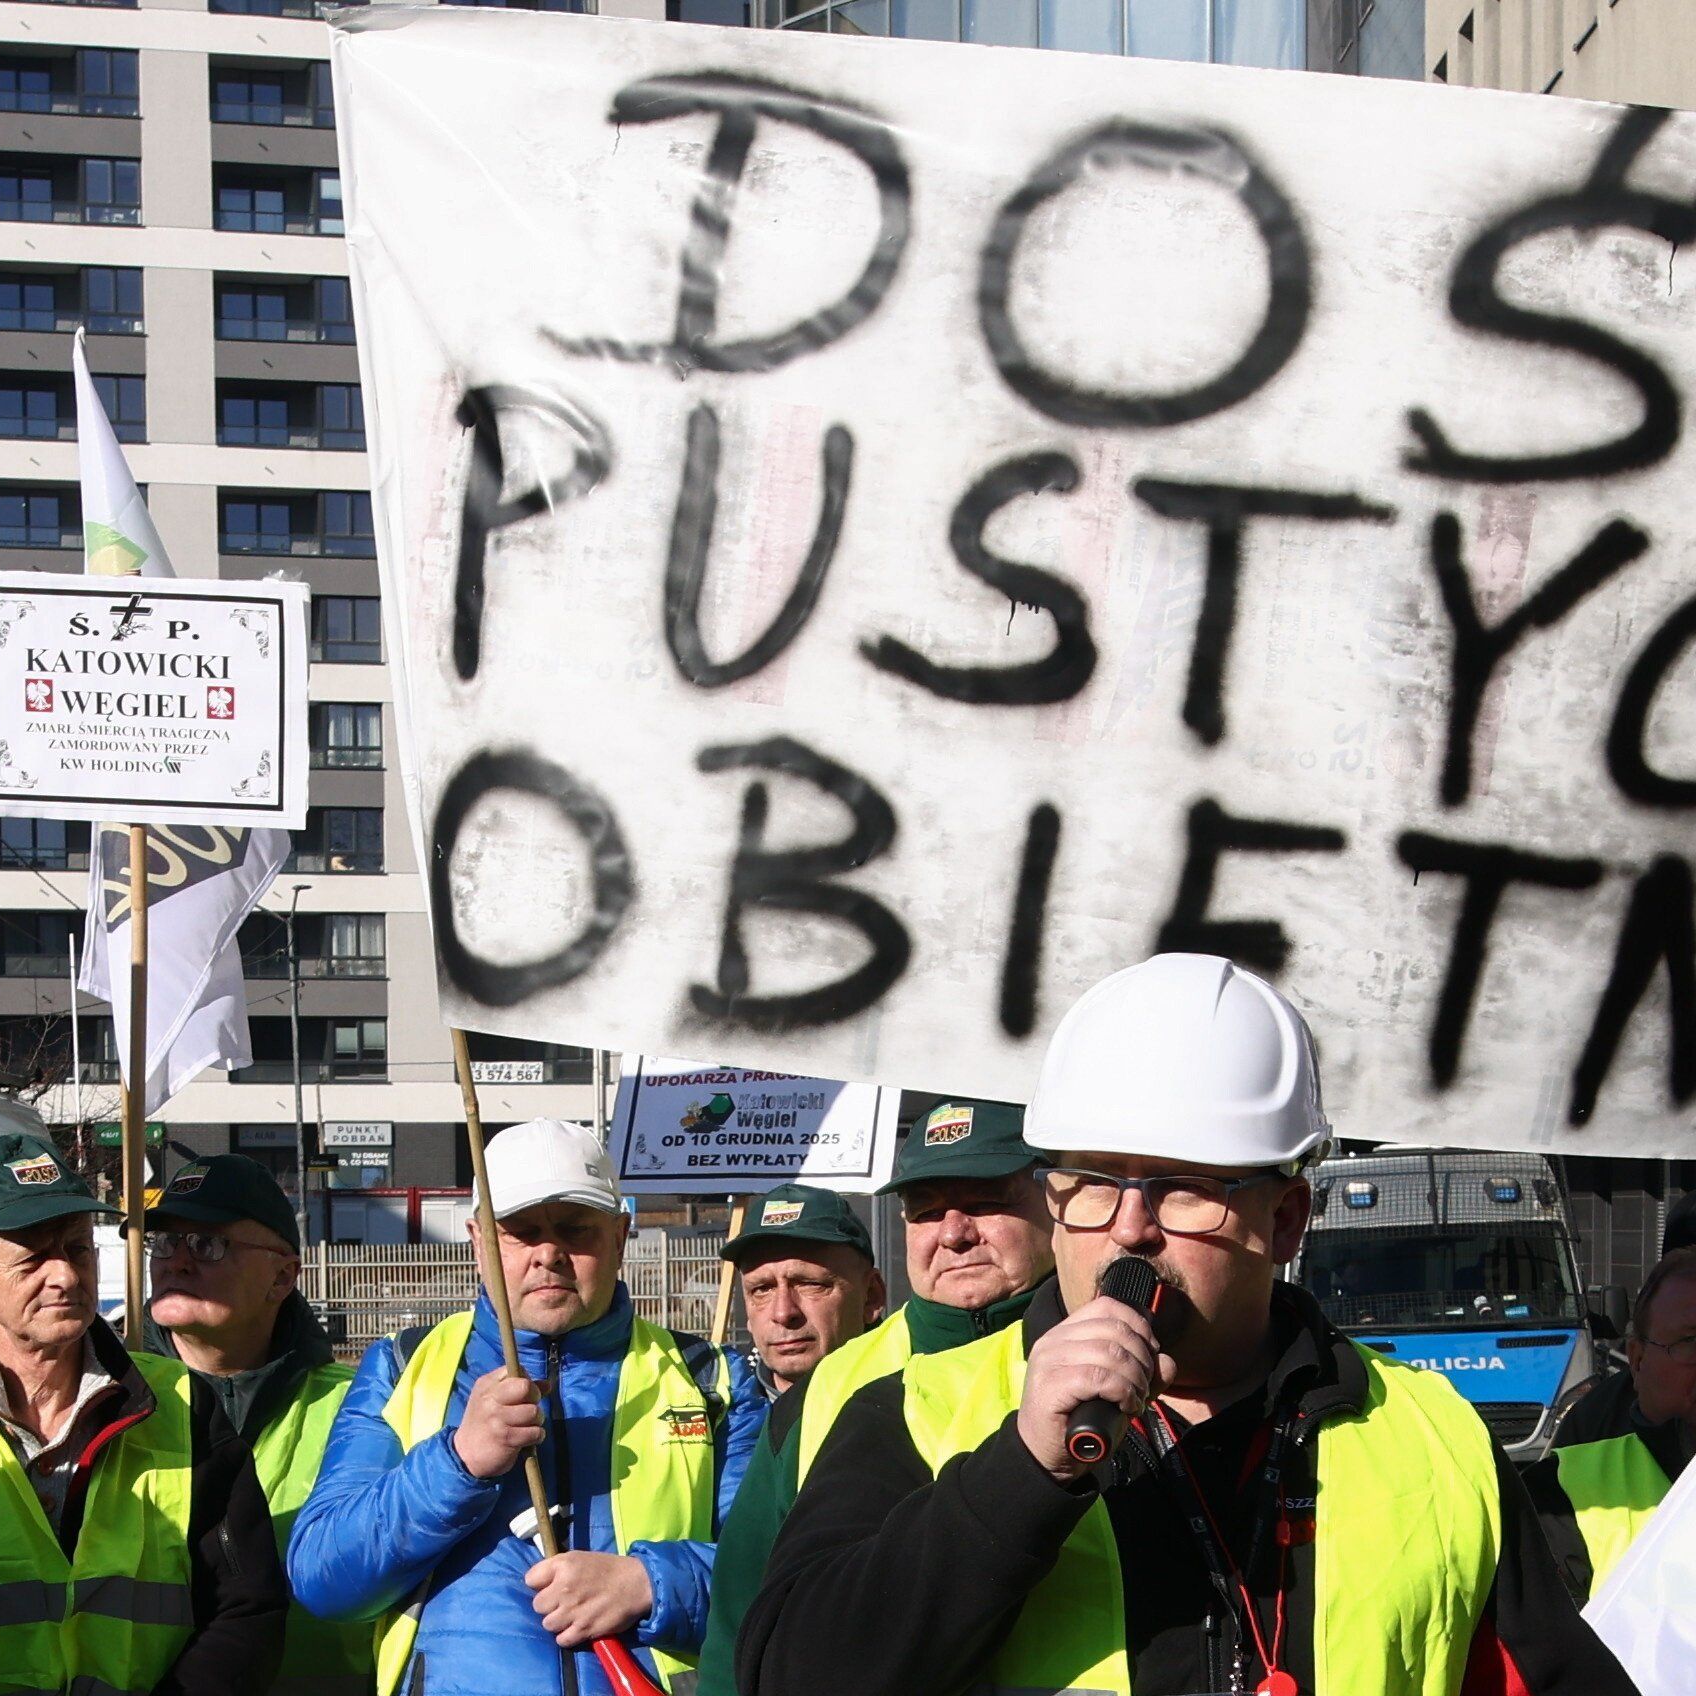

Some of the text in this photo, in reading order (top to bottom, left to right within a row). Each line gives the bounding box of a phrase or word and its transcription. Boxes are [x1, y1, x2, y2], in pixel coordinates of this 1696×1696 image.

[69, 612, 200, 640] Ś. P.
[25, 647, 230, 680] KATOWICKI
[61, 690, 197, 722] WĘGIEL
[26, 721, 231, 743] ZMARŁ ŚMIERCIĄ TRAGICZNĄ
[48, 737, 209, 756] ZAMORDOWANY PRZEZ
[60, 757, 164, 775] KW HOLDING
[645, 1072, 737, 1087] UPOKARZA
[737, 1093, 825, 1110] Katowicki
[737, 1111, 797, 1129] Węgiel
[337, 1125, 379, 1134] PUNKT
[332, 1133, 386, 1144] POBRAŃ
[661, 1133, 840, 1147] OD 10 GRUDNIA 2025
[687, 1153, 808, 1167] BEZ WYPŁATY
[1401, 1356, 1506, 1371] OLICJA
